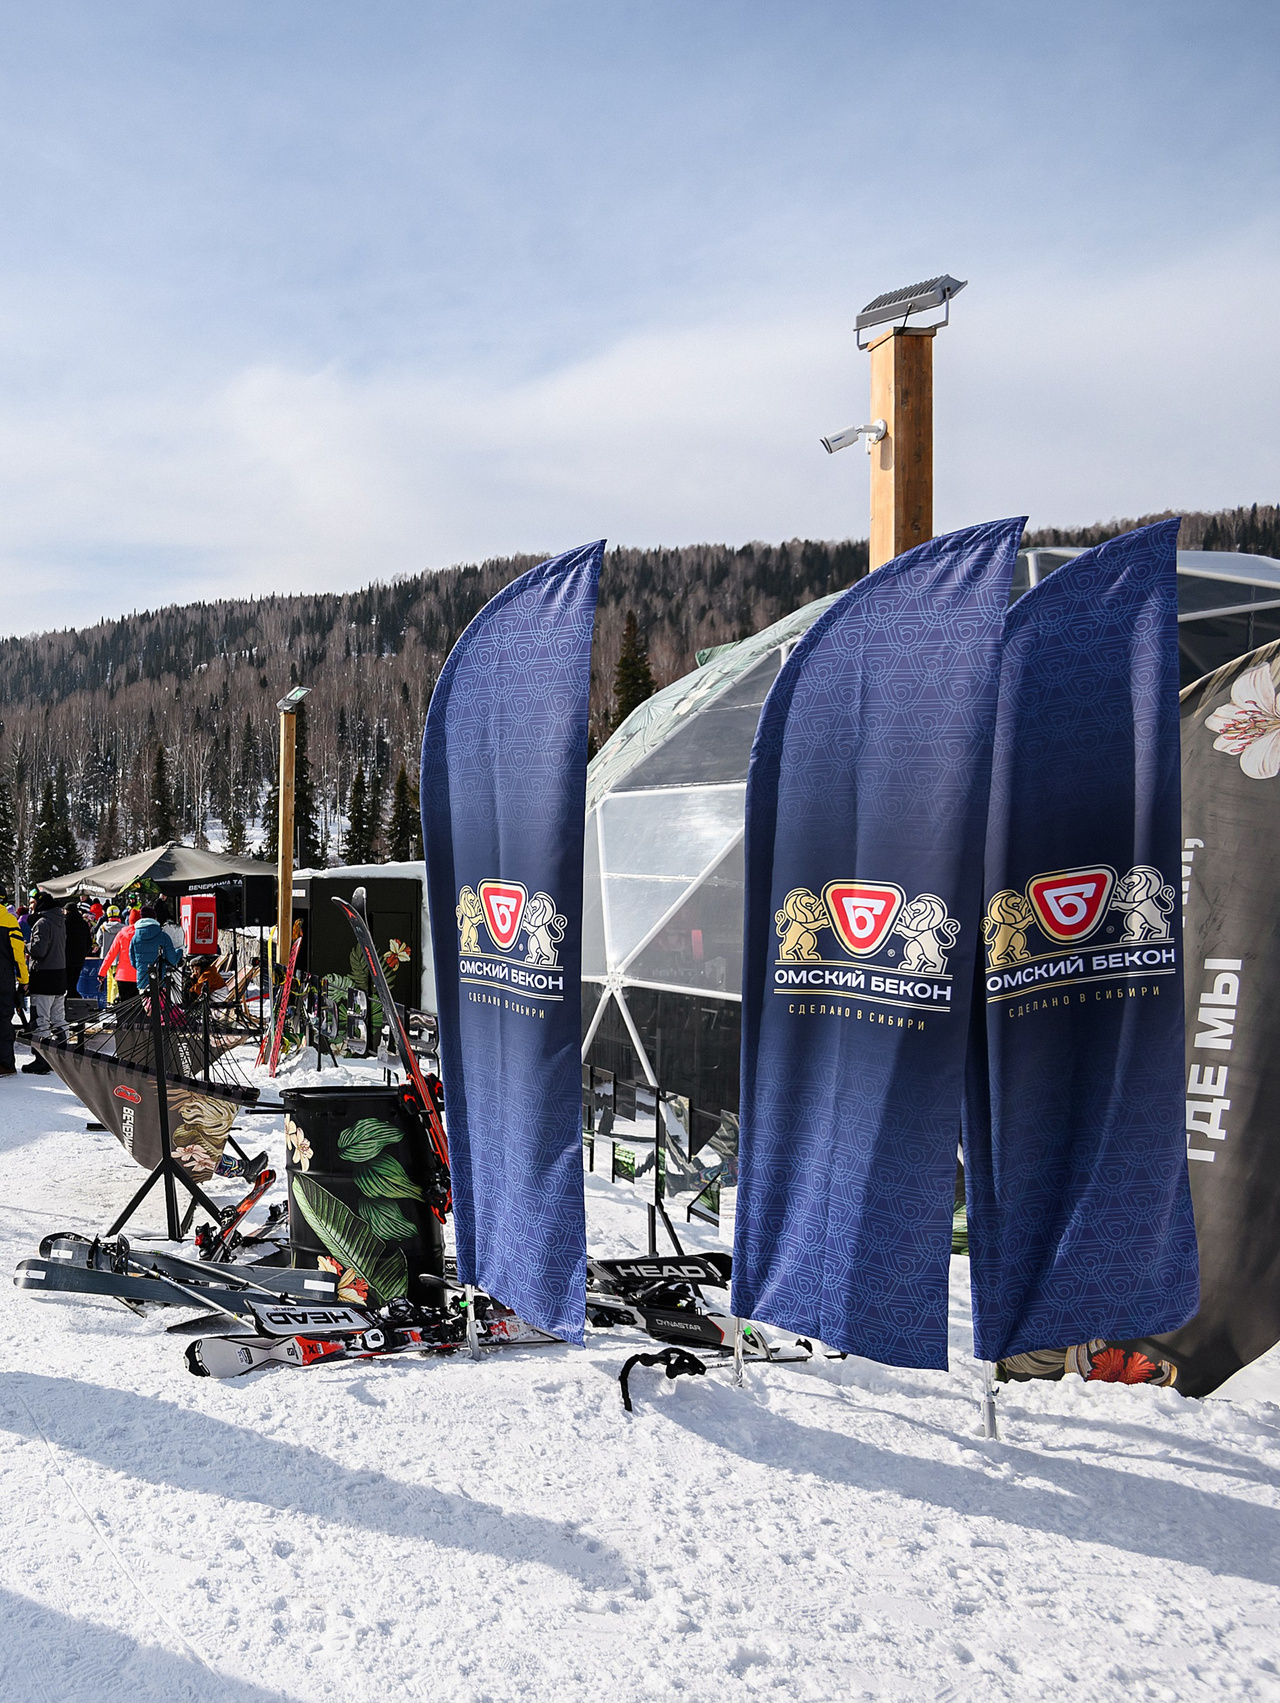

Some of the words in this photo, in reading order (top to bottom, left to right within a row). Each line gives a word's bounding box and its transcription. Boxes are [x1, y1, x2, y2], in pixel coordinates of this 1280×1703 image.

[459, 960, 509, 981] ОМСКИЙ
[511, 968, 564, 990] БЕКОН
[985, 955, 1084, 992] ОМСКИЙ
[1092, 948, 1176, 971] БЕКОН
[774, 969, 865, 989] ОМСКИЙ
[870, 975, 952, 1001] БЕКОН
[468, 992, 500, 1007] СДЕЛАНО
[511, 1002, 545, 1019] СИБИРИ
[1008, 995, 1070, 1018] СДЕЛАНО
[1080, 993, 1086, 1003] В
[1095, 986, 1160, 1001] СИБИРИ
[1193, 958, 1243, 1050] МЫ
[789, 1004, 850, 1018] СДЕЛАНО
[857, 1009, 863, 1020] В
[869, 1012, 925, 1031] СИБИРИ
[616, 1265, 707, 1278] HEAD
[265, 1311, 354, 1325] HEAD
[655, 1318, 702, 1332] DYNASTAR
